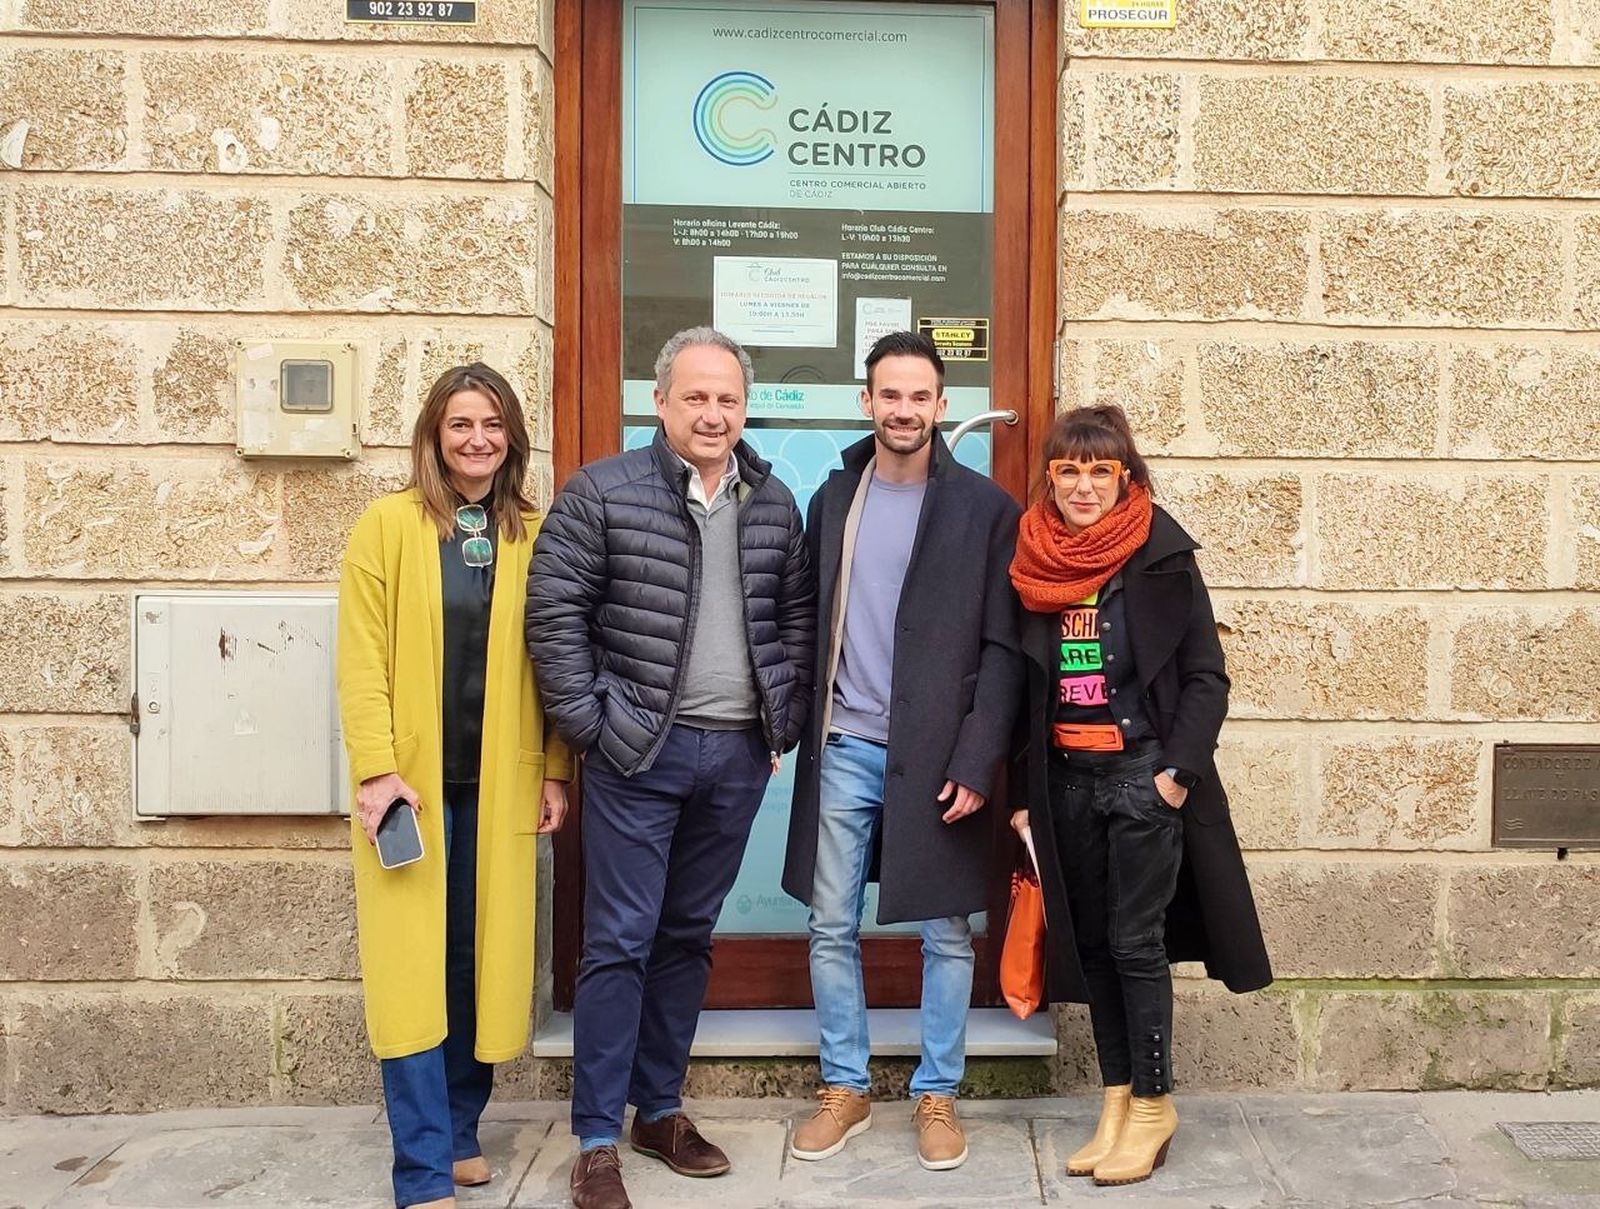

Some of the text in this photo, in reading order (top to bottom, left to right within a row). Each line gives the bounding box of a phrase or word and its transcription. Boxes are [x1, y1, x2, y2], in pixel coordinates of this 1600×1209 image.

[369, 2, 454, 17] 902 23 92 87
[1088, 9, 1168, 20] PROSEGUR
[712, 26, 908, 43] www.cadizcentrocomercial.com
[788, 102, 893, 134] CÁDIZ
[787, 141, 927, 169] CENTRO
[789, 179, 927, 190] CENTRO COMERCIAL ABIERTO
[789, 189, 833, 198] DE CÁDIZ
[673, 218, 781, 229] Horario oficina Levante Cádiz:
[841, 223, 868, 232] Horario
[870, 224, 886, 233] Club
[887, 224, 908, 233] Cádiz
[717, 229, 740, 237] 14h00
[745, 230, 768, 239] 17h00
[858, 233, 880, 242] 10h00
[709, 239, 731, 247] 14h00
[841, 252, 875, 260] ESTAMOS
[876, 252, 881, 260] A
[882, 253, 892, 261] SU
[841, 262, 860, 270] PARA
[861, 262, 900, 271] CUALQUIER
[901, 263, 937, 272] CONSULTA
[935, 329, 972, 339] STANLEY
[775, 388, 805, 402] Cádiz
